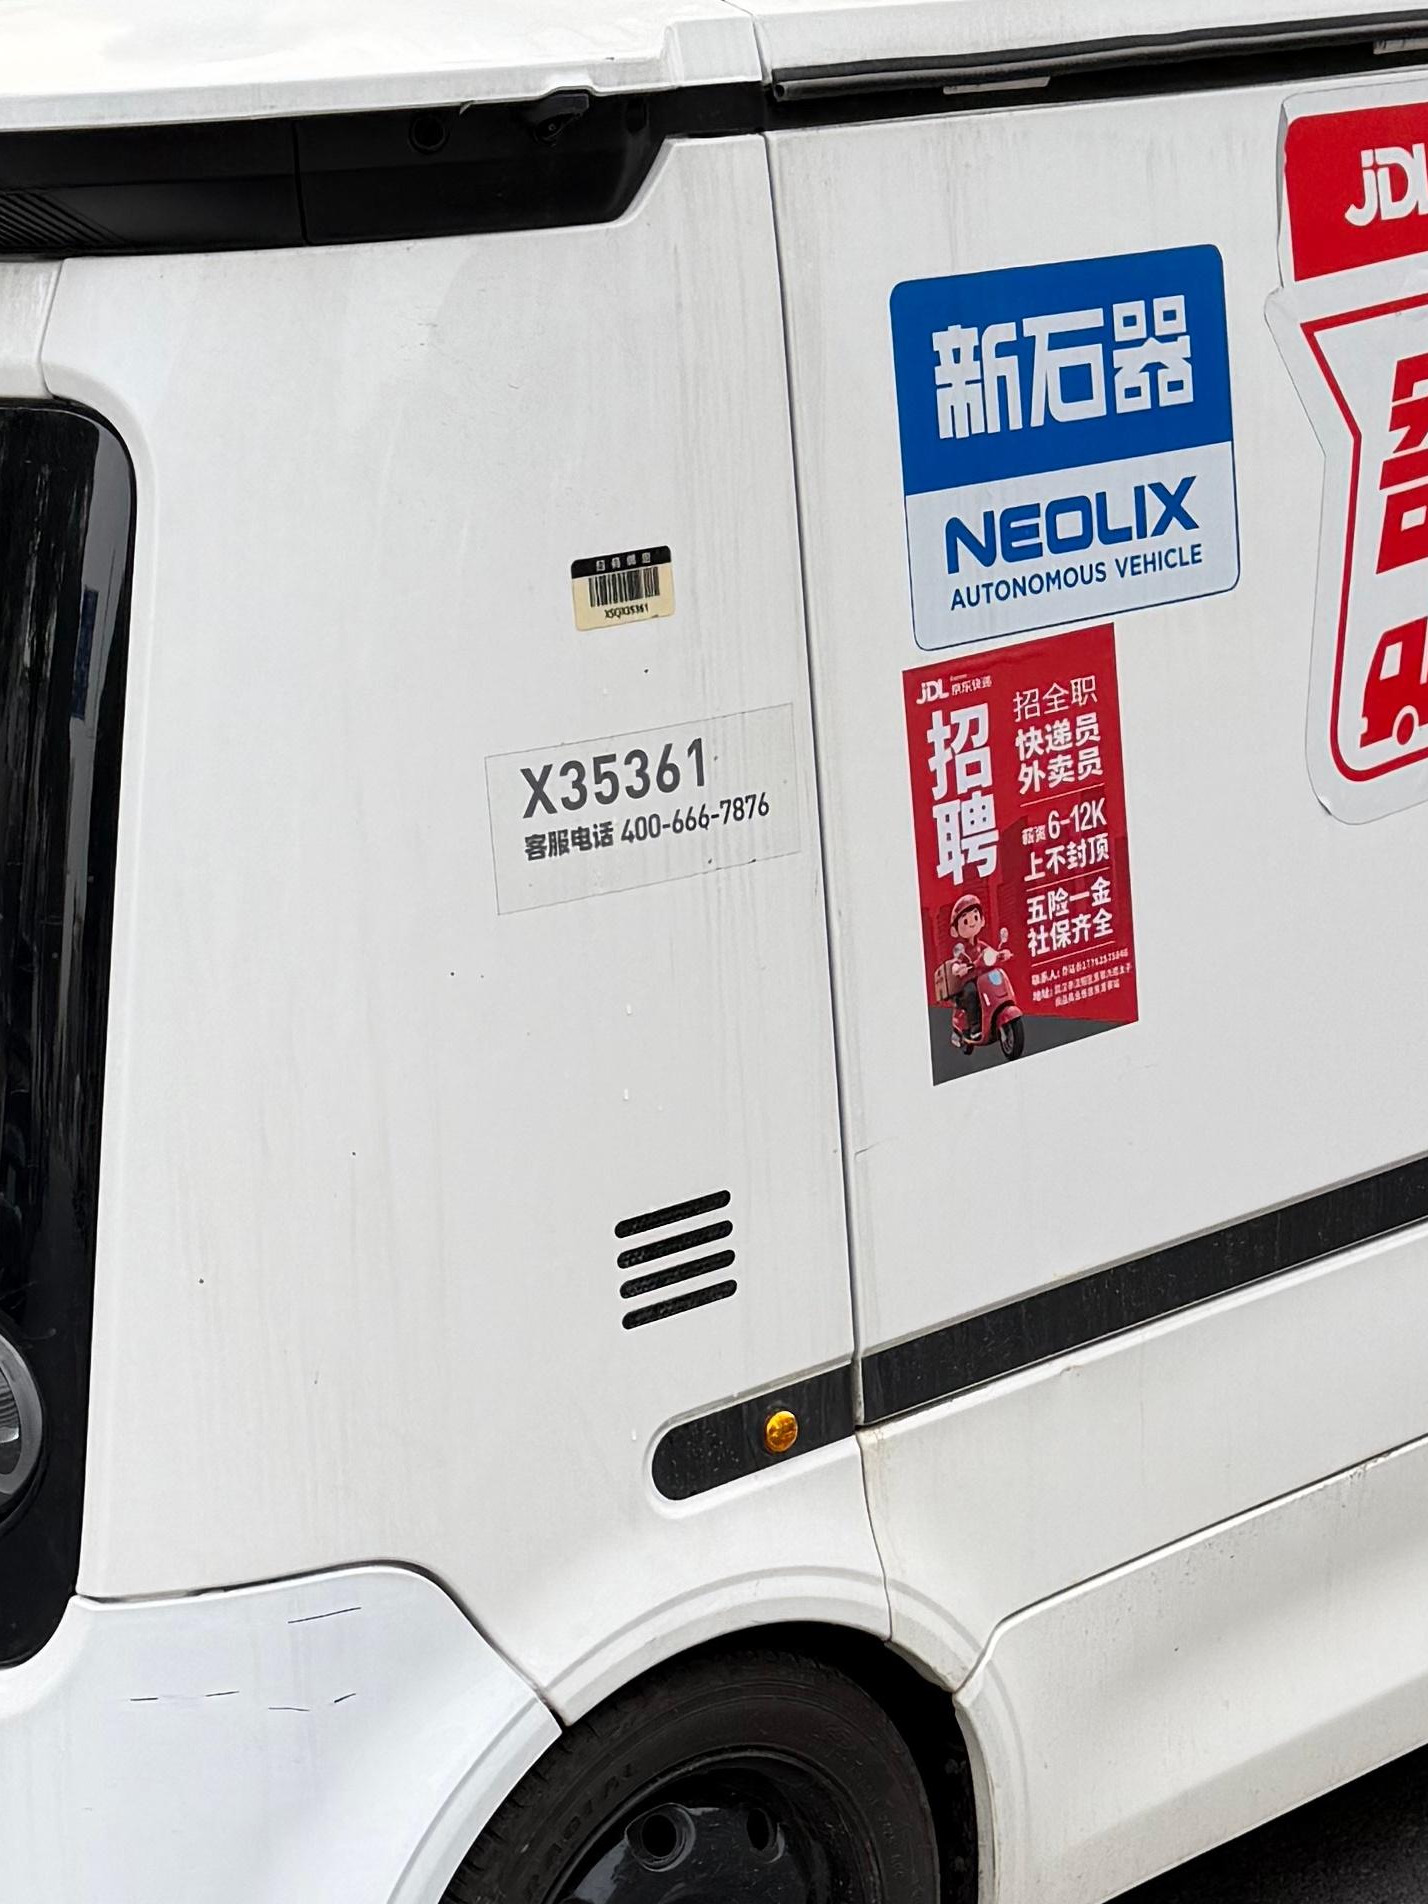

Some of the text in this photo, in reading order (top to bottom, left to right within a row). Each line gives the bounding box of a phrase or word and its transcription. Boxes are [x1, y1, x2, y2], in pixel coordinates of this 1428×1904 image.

[932, 294, 1194, 441] 新石器
[945, 475, 1200, 575] NEOLIX
[950, 543, 1203, 611] AUTONOMOUS VEHICLE
[1013, 675, 1098, 723] 招全职
[1015, 712, 1101, 761] 快递员
[520, 737, 706, 819] X35361
[927, 702, 1000, 886] 招聘
[1018, 746, 1103, 795] 外卖员
[523, 791, 771, 861] 客服电话 400-666-7876
[1024, 832, 1110, 882] 上不封顶
[1027, 876, 1112, 925] 五险一金
[1028, 907, 1114, 957] 社保齐全
